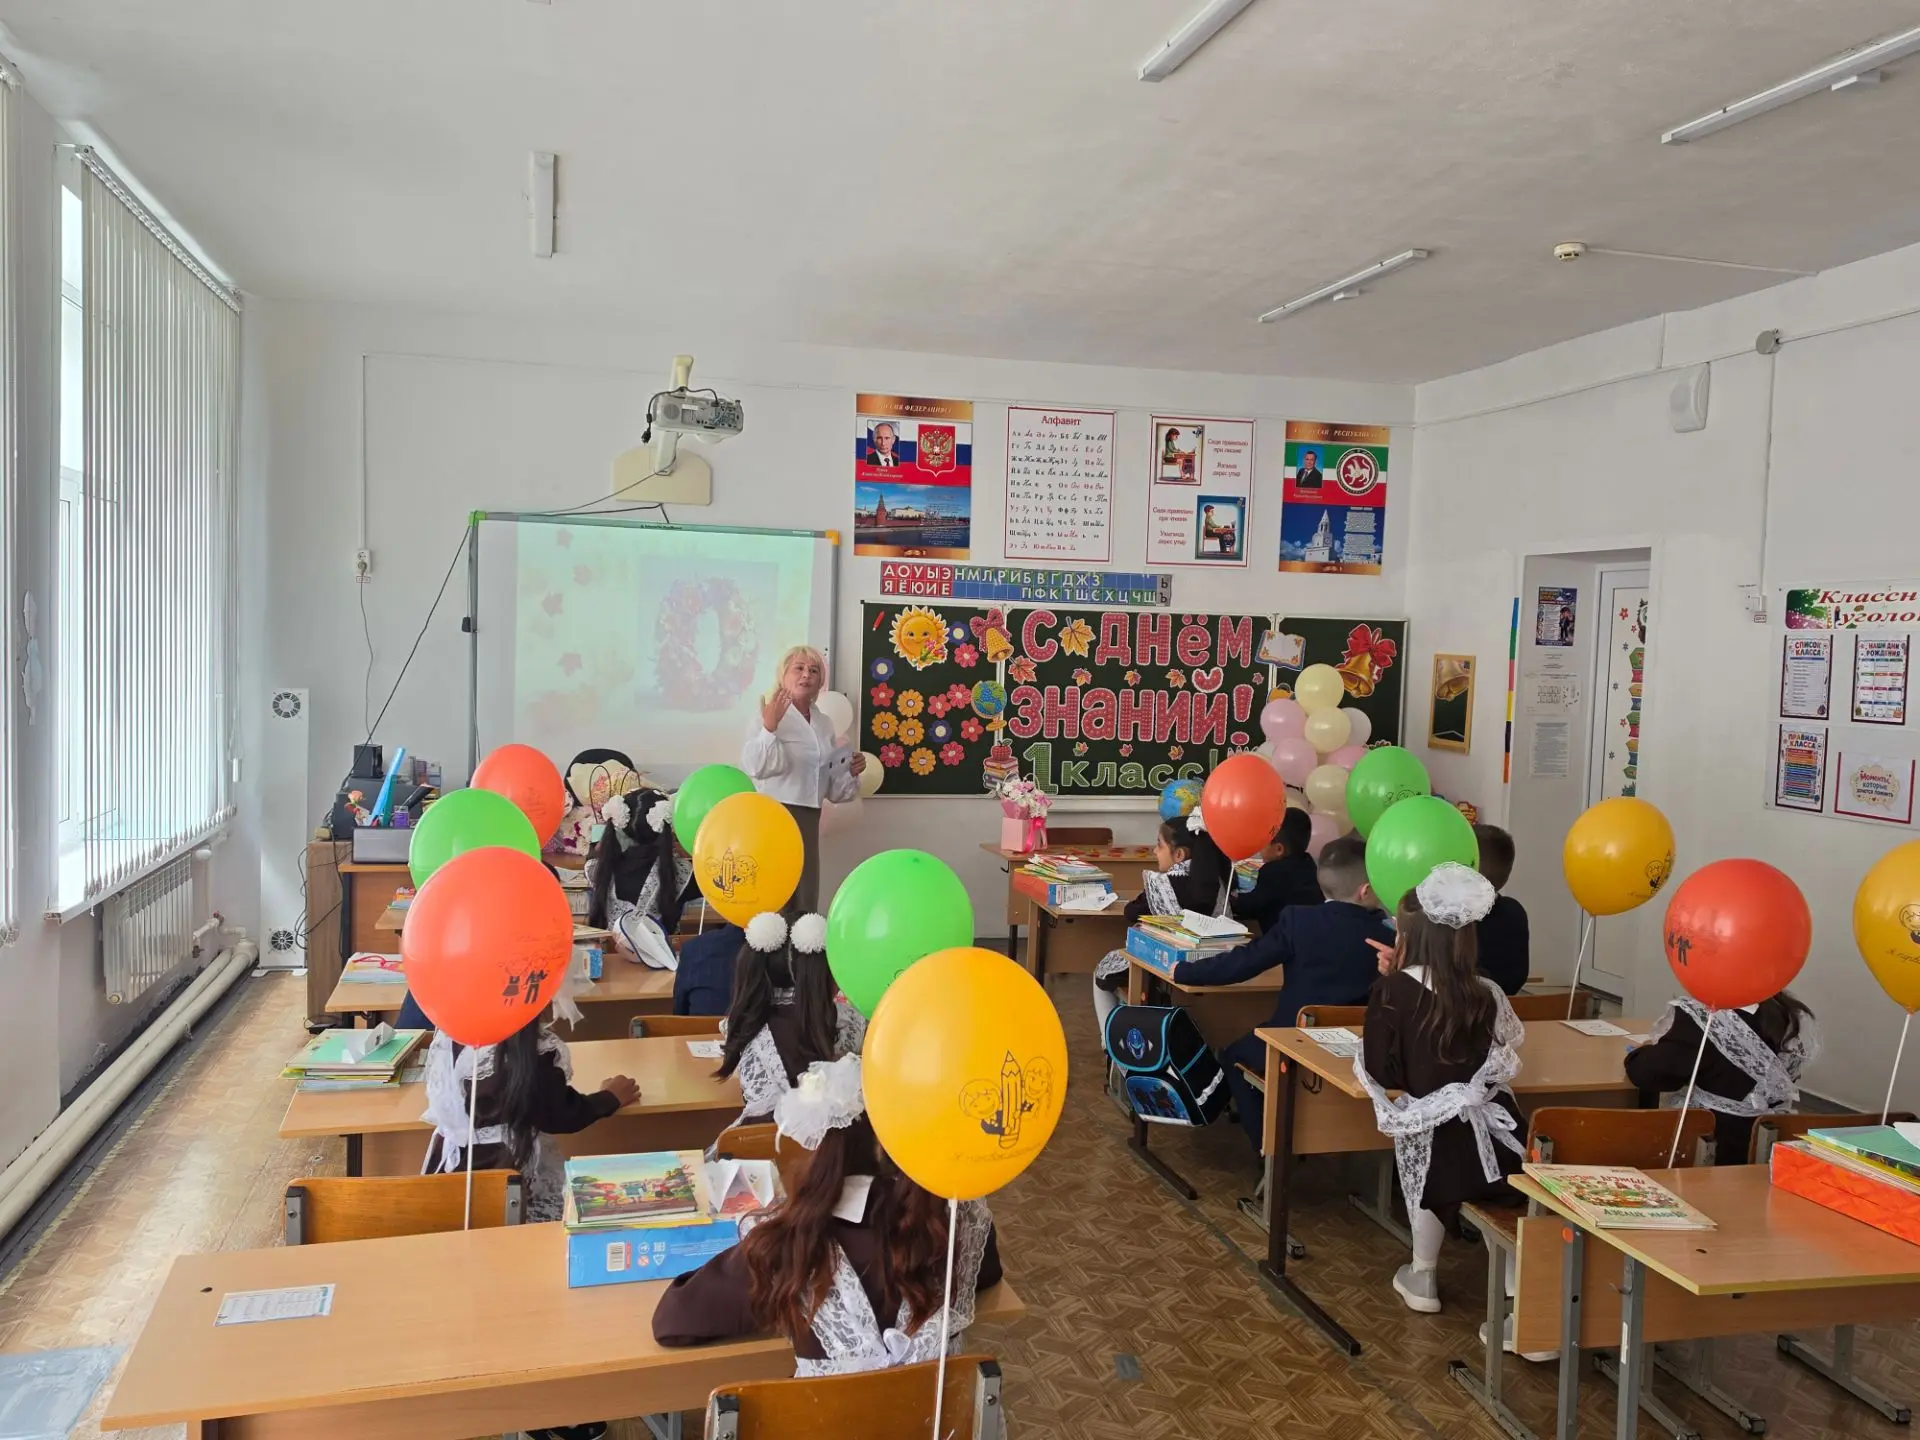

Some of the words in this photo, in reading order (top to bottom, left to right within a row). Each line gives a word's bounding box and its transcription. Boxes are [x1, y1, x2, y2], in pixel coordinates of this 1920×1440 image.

[1041, 415, 1081, 426] Алфавит
[1022, 609, 1058, 662] С
[1838, 612, 1920, 626] уголо
[1023, 742, 1058, 795] 1
